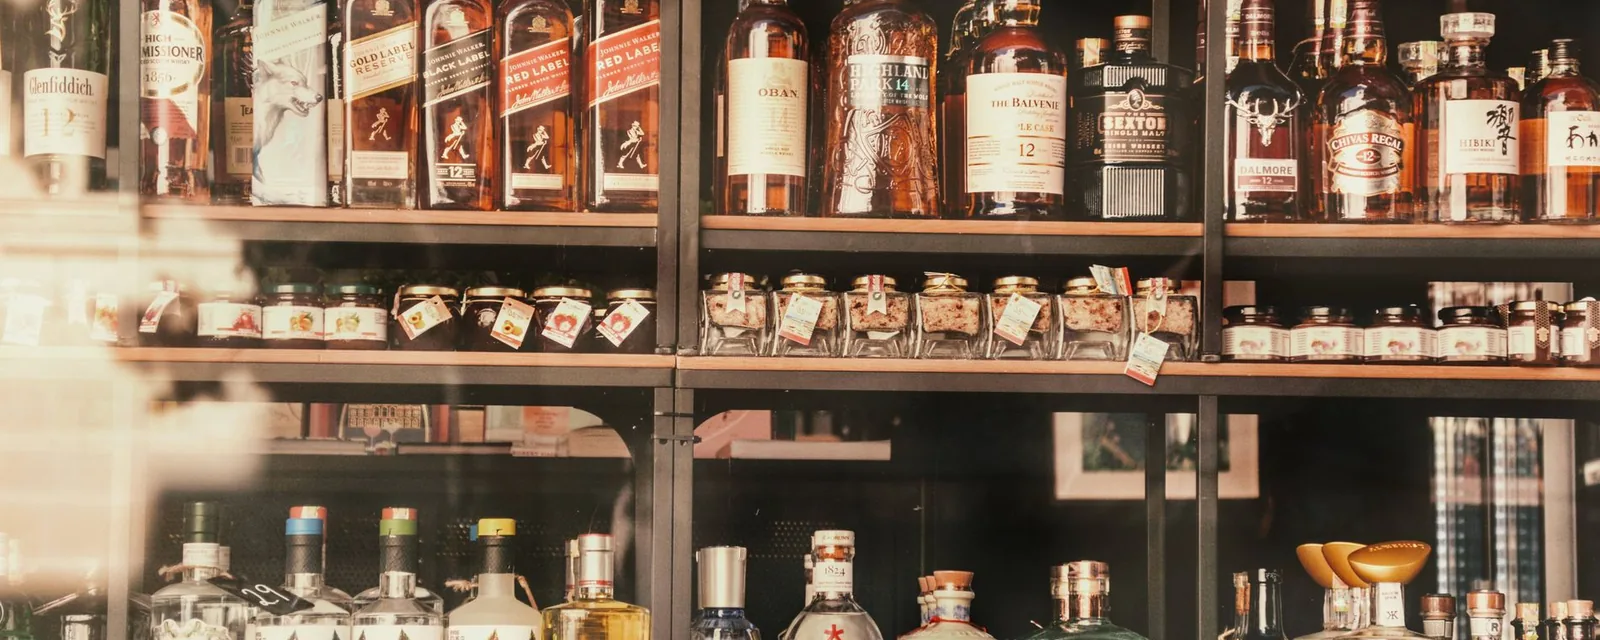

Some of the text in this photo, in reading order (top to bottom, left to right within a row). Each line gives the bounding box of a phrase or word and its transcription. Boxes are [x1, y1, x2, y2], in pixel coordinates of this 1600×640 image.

[145, 34, 171, 43] HIGH
[350, 53, 378, 68] GOLD
[379, 42, 415, 58] LABEL
[600, 41, 631, 57] JOHNNIE
[355, 51, 414, 75] RESERVE
[427, 52, 456, 66] JOHNNIE
[597, 42, 660, 71] RED LABE
[423, 51, 490, 78] BLACK LABEL
[506, 58, 570, 85] RED LABEL
[509, 58, 538, 73] JOHNNIE
[850, 64, 929, 80] HIGHLAND
[29, 76, 93, 96] Glenfiddich
[896, 78, 910, 91] 14
[759, 88, 798, 98] OBAN
[991, 97, 1060, 110] THE BALVENIE
[41, 108, 76, 138] 12
[1103, 117, 1166, 130] SEXTON
[1331, 133, 1402, 151] CHIVAS REGAL
[1459, 139, 1495, 147] HIBIKI
[1020, 143, 1035, 157] 12
[1362, 151, 1374, 161] 12
[448, 166, 463, 178] 12
[1240, 166, 1293, 175] DALMORE
[1262, 177, 1272, 185] 12
[824, 565, 846, 576] 1824
[241, 584, 290, 606] 29
[1491, 622, 1499, 632] R
